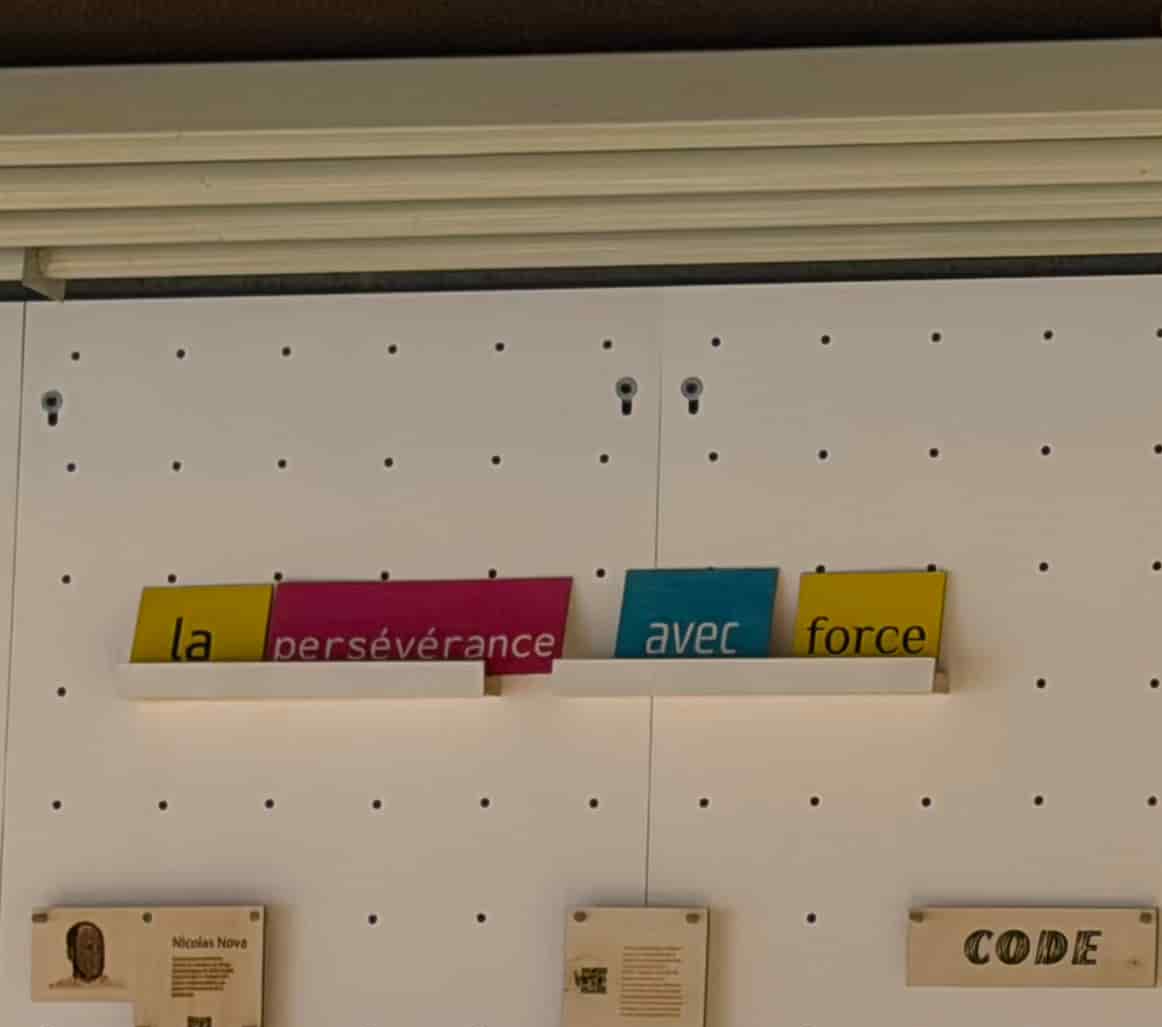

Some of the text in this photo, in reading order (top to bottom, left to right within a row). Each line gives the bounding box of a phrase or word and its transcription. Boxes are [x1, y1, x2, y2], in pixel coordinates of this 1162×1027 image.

[169, 616, 213, 662] la
[273, 626, 556, 662] persévérance
[645, 619, 741, 656] avec
[806, 615, 927, 656] force
[172, 935, 248, 949] Nicolas Nova
[963, 929, 1103, 966] CODE
